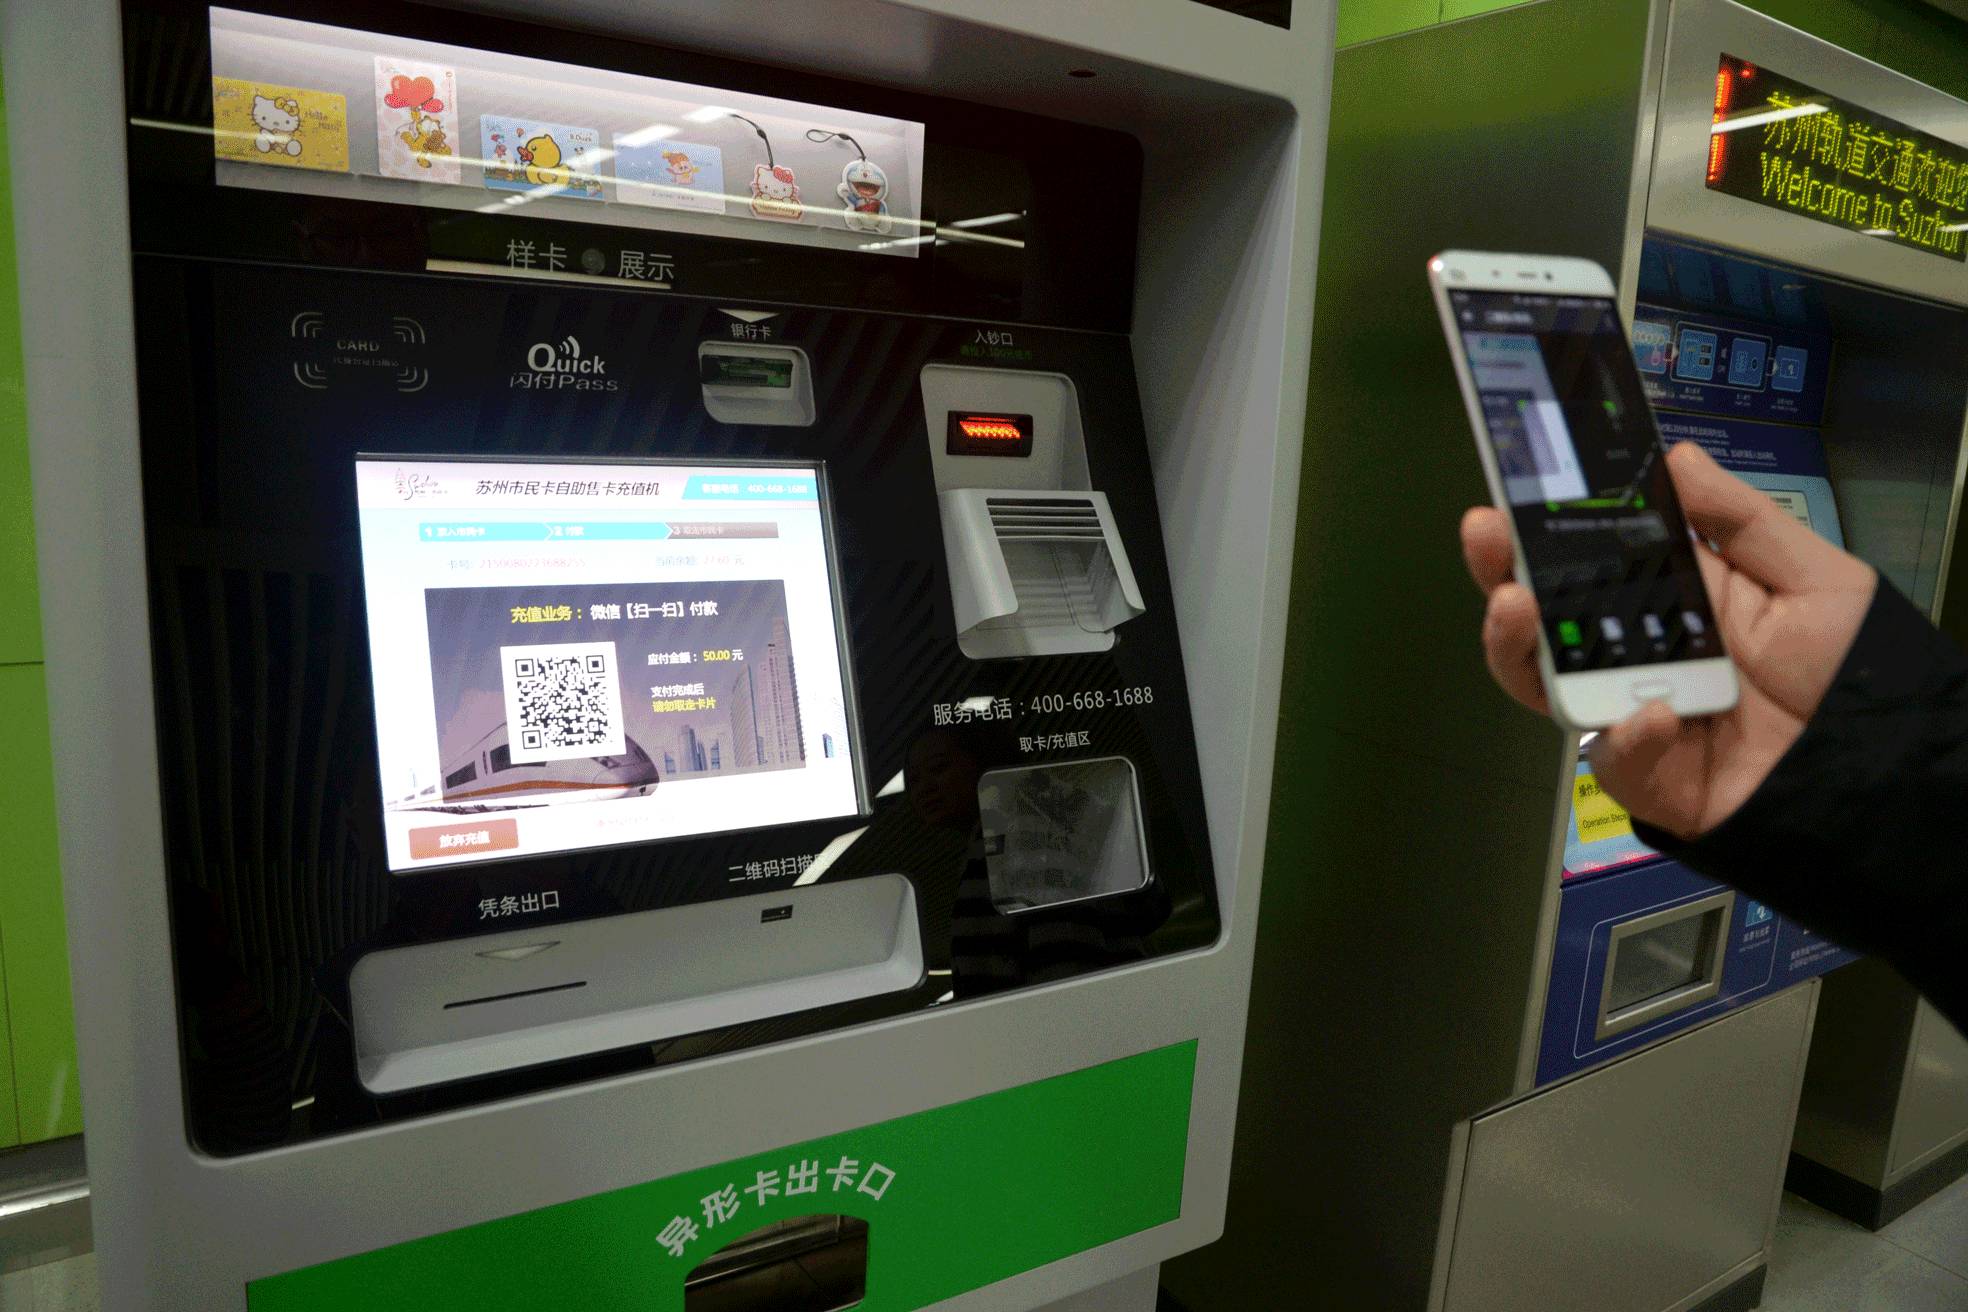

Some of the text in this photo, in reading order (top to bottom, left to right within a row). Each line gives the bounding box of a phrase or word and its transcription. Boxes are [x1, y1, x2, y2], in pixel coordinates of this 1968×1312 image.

[1760, 151, 1868, 225] Welcome
[1872, 193, 1893, 232] to
[506, 239, 674, 281] 样卡 展示
[730, 322, 772, 341] 银行卡
[974, 329, 1014, 347] 入钞口
[336, 339, 380, 352] CARD
[527, 336, 606, 374] Quick
[475, 479, 660, 497] 苏州市民卡自助售卡充值机
[703, 649, 731, 662] 50.00
[732, 649, 744, 661] 元
[650, 682, 705, 698] 支付完成后
[1019, 730, 1092, 753] 取卡/充值区
[478, 890, 560, 920] 凭条出口
[655, 1155, 897, 1257] 异形卡出卡口
